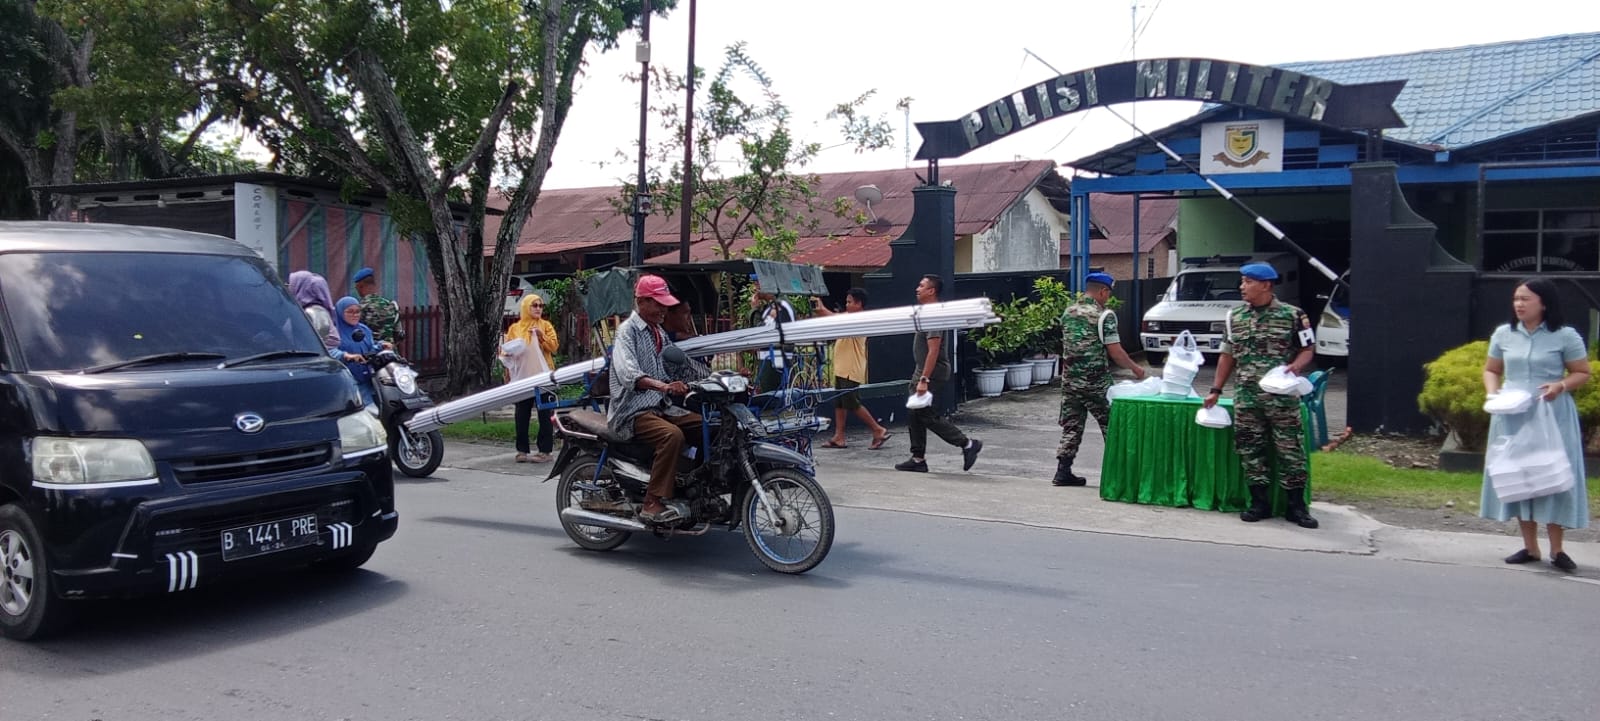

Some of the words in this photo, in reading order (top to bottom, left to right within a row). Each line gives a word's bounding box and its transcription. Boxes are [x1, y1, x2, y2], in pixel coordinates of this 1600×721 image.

[961, 68, 1098, 149] POLISI
[1136, 58, 1333, 121] MILITER
[224, 532, 234, 550] B
[248, 523, 280, 545] 1441
[292, 516, 317, 536] PRE
